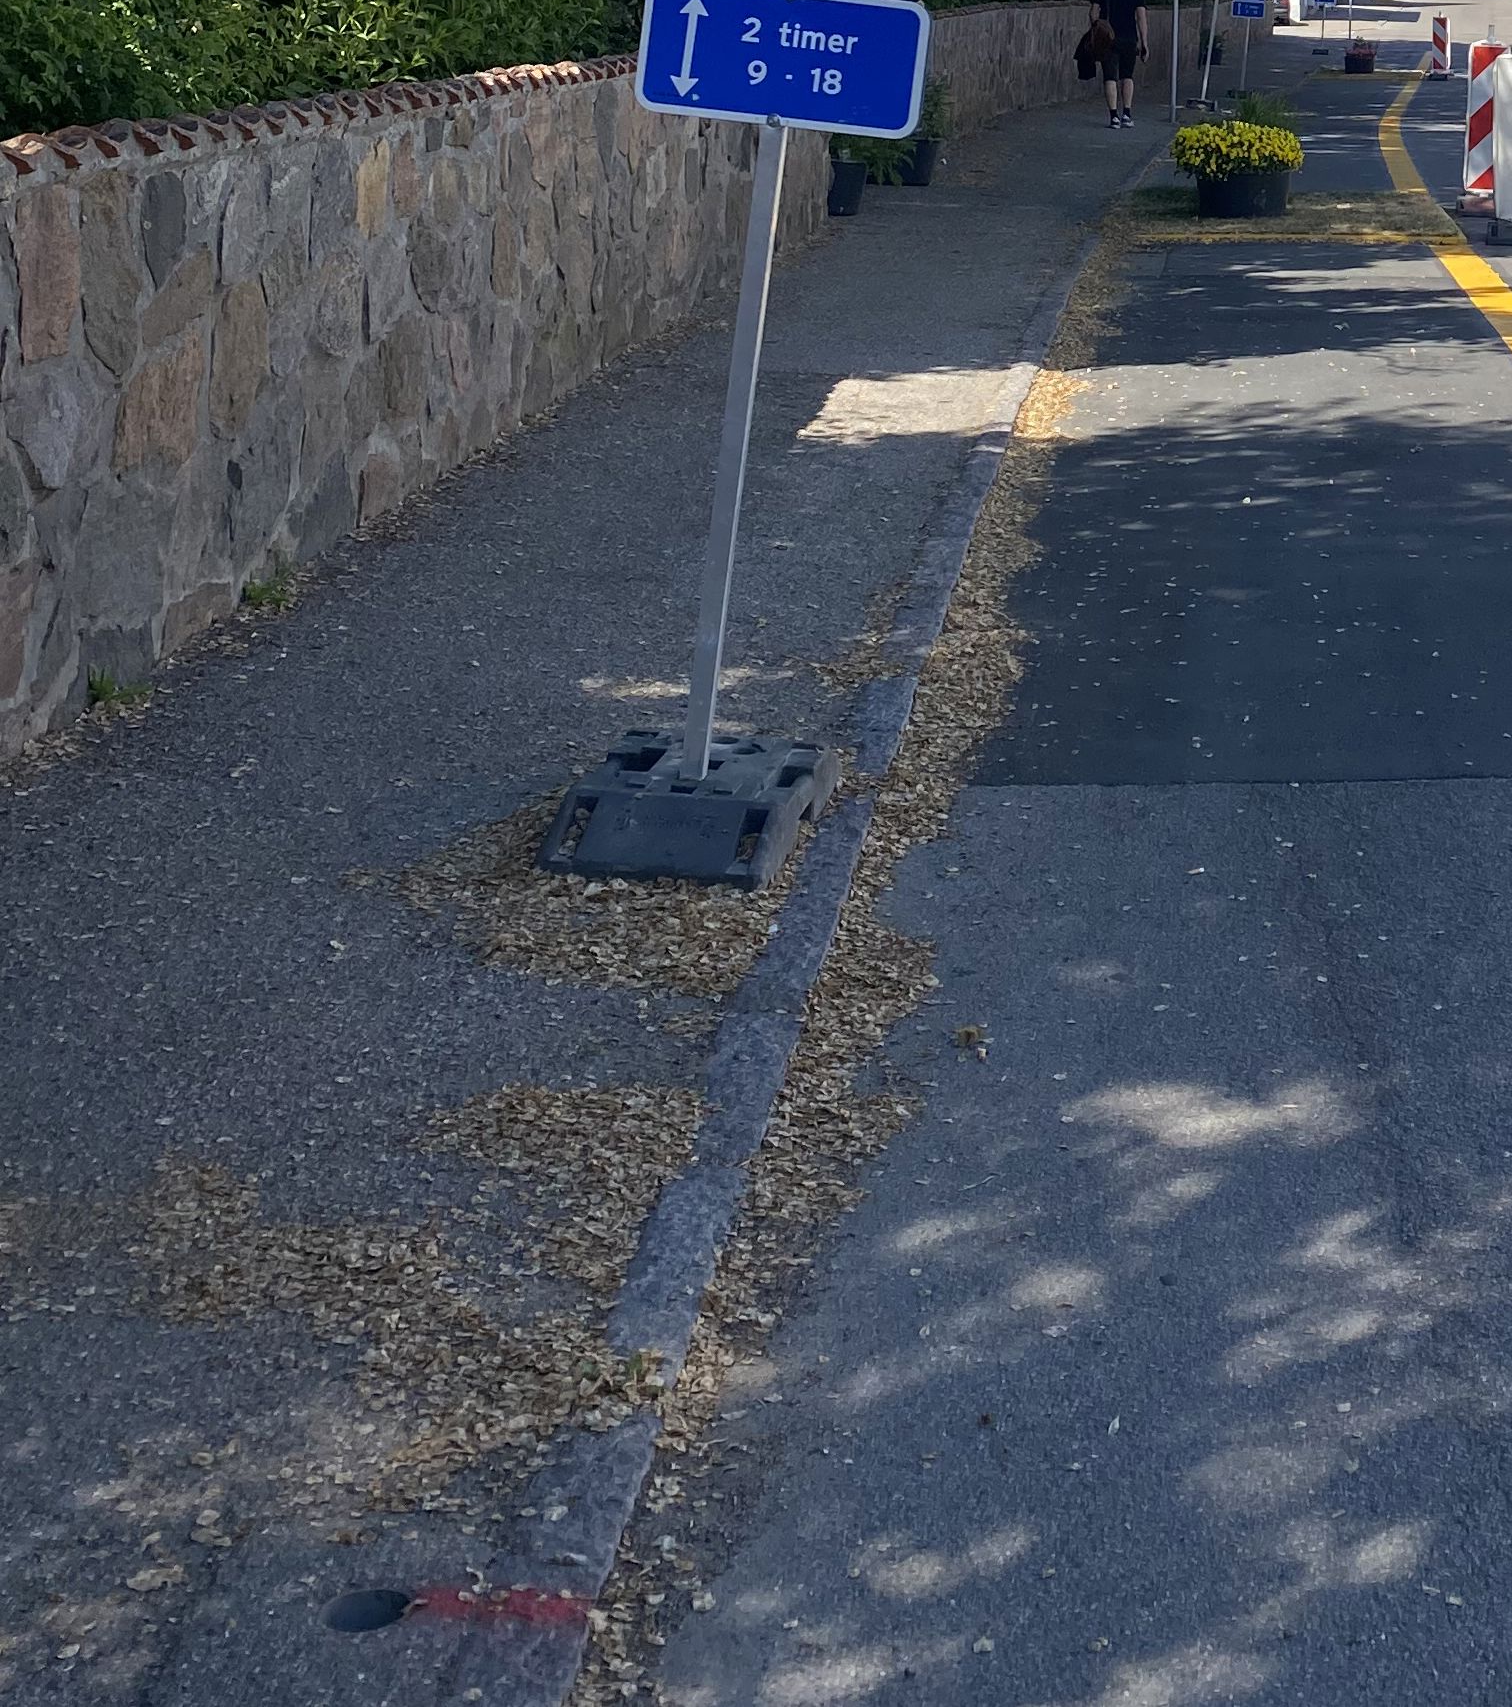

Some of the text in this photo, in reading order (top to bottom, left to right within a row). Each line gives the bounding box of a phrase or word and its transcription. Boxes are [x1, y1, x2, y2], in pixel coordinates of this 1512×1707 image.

[741, 17, 859, 55] 2 timer
[748, 60, 767, 86] 9
[810, 68, 843, 95] 18
